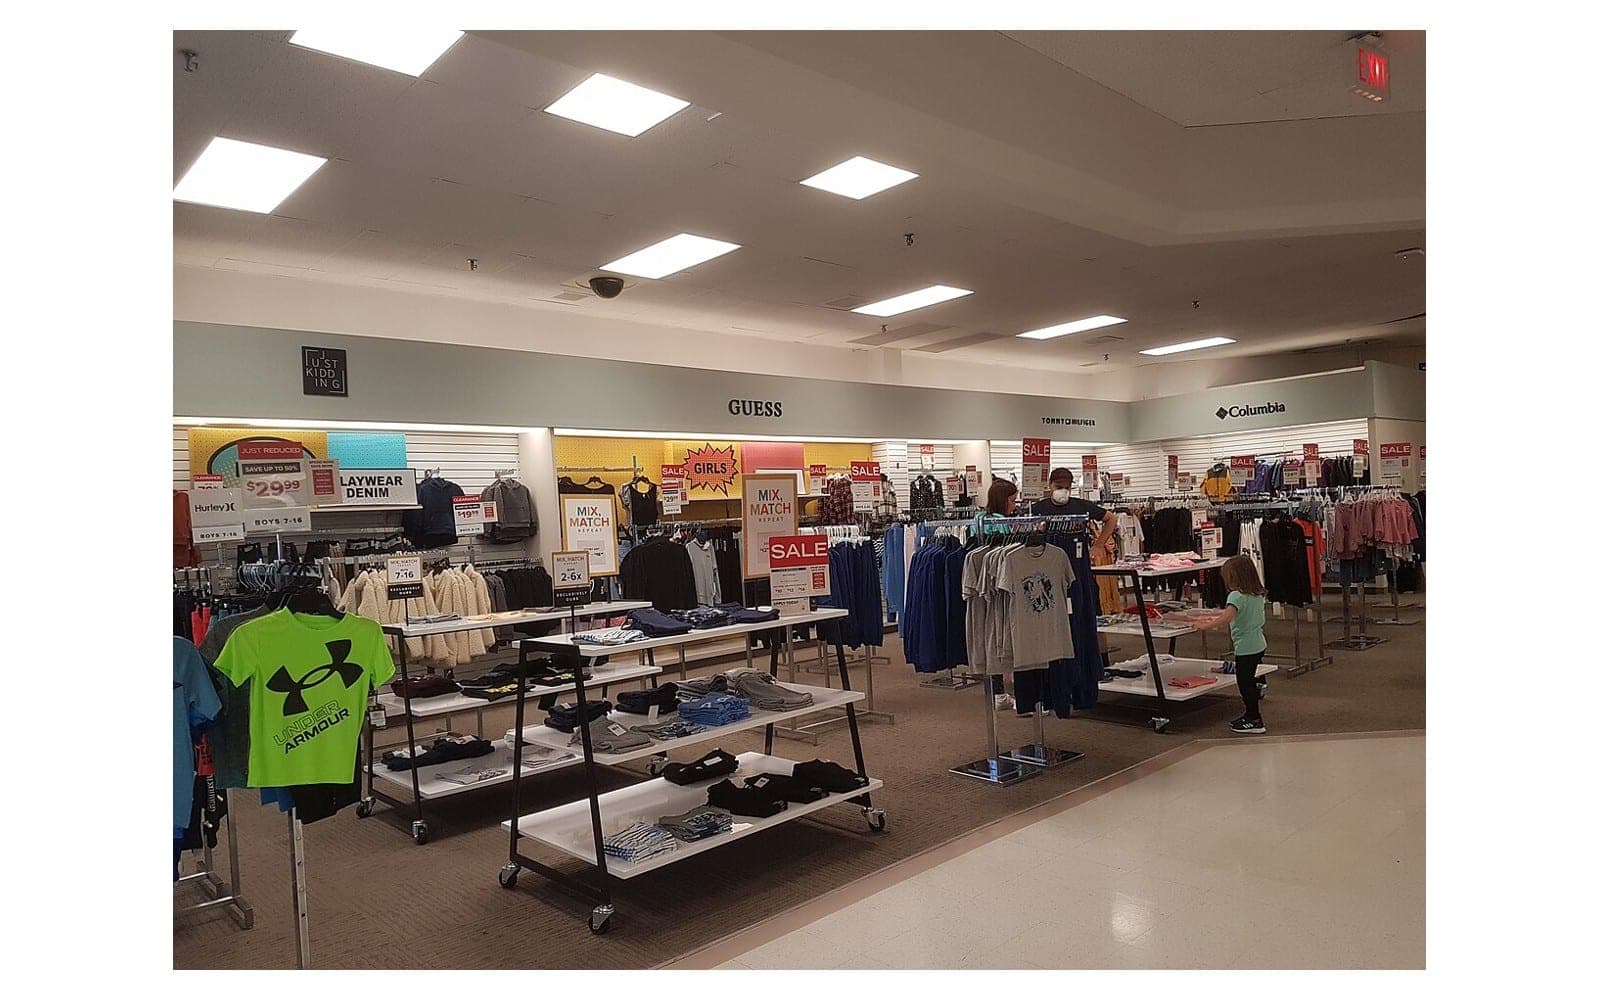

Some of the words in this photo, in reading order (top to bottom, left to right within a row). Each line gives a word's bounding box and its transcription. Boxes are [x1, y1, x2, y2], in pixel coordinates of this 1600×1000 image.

[1358, 47, 1388, 91] EXIT
[728, 399, 783, 417] GUESS
[1229, 401, 1286, 418] Columbia
[263, 446, 301, 454] REDUCED
[1023, 444, 1050, 457] SALE
[1381, 445, 1411, 454] SALE
[662, 467, 684, 475] SALE
[694, 462, 727, 474] GIRLS
[851, 465, 880, 476] SALE
[340, 476, 403, 486] LAYWEAR
[346, 487, 389, 498] DENIM
[758, 489, 783, 501] MIX,
[194, 503, 225, 512] Hurley
[577, 506, 601, 517] MIX,
[750, 503, 791, 515] MATCH
[255, 518, 280, 526] BOYS
[283, 516, 302, 524] 7-16
[569, 518, 609, 527] MATCH
[771, 542, 828, 559] SALE
[395, 571, 414, 579] 7-16
[273, 700, 340, 746] UNDER
[285, 708, 350, 754] ARMOUR
